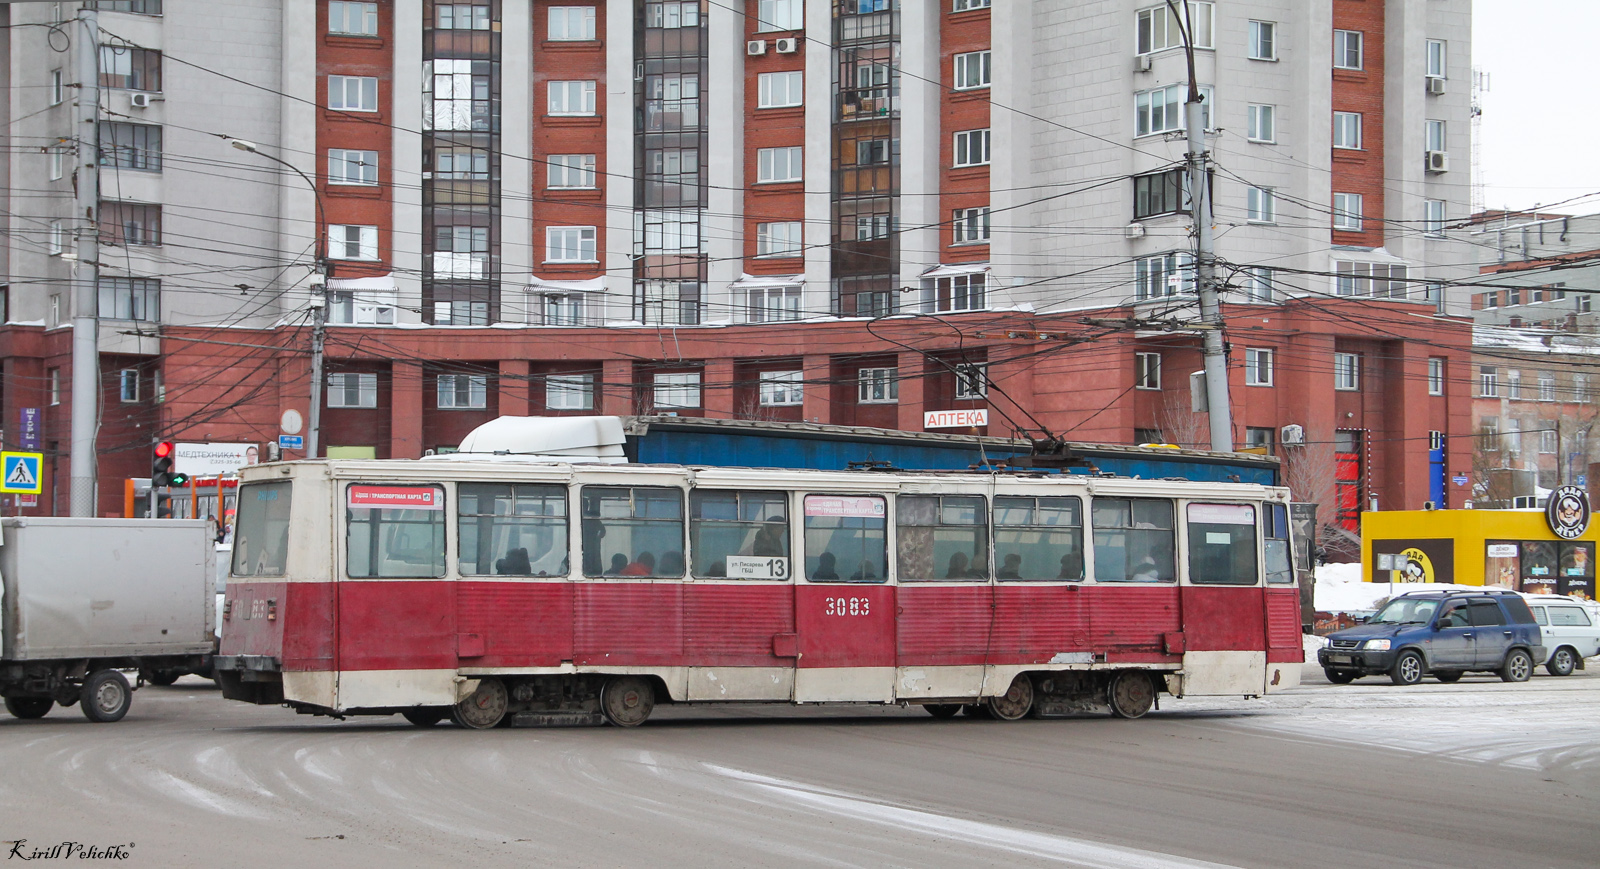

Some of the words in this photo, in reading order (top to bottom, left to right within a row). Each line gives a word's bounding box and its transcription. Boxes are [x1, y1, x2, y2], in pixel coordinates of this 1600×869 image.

[927, 412, 985, 426] АПТЕКА
[1406, 551, 1424, 562] ЯДЯ
[766, 559, 785, 577] 13
[825, 597, 870, 616] 3083
